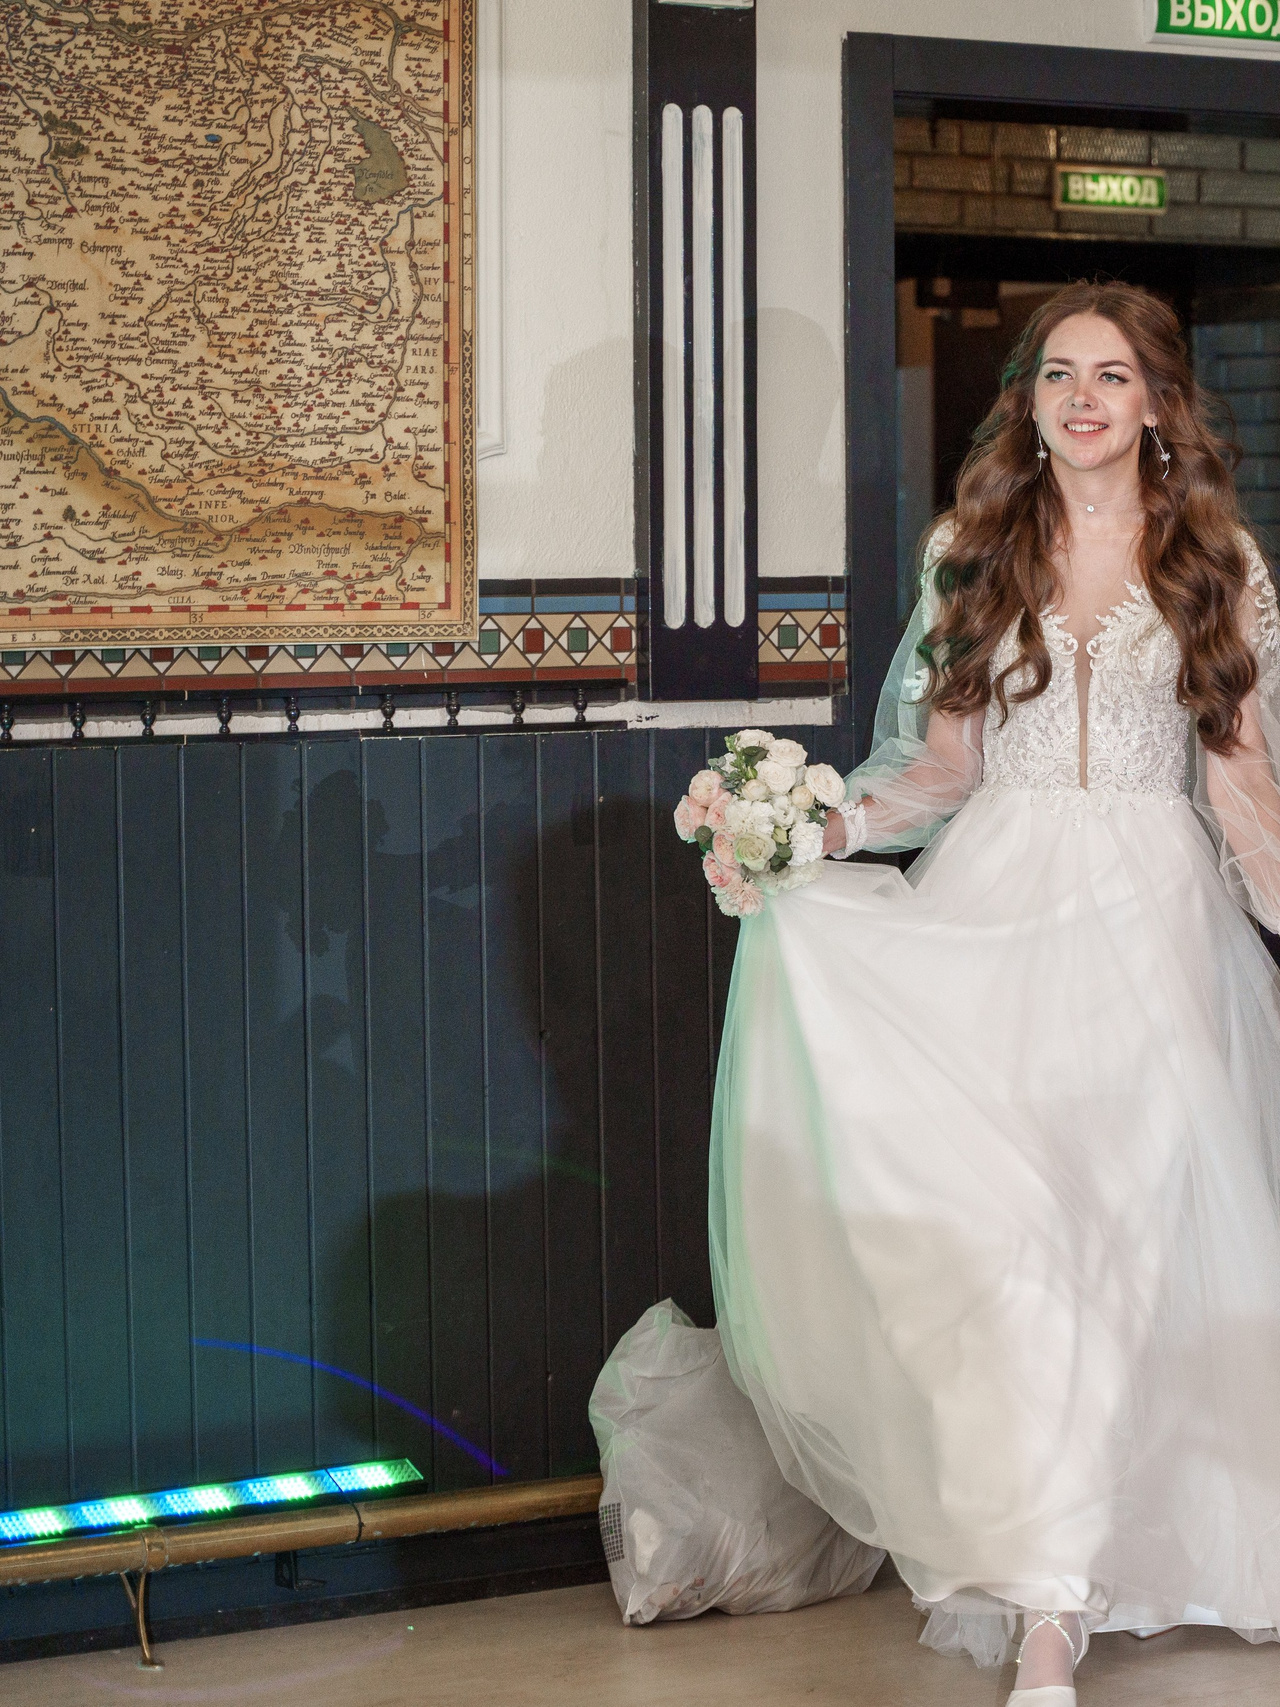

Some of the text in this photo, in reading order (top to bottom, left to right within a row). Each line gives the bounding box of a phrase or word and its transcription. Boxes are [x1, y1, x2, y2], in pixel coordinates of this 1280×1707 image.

[1067, 174, 1159, 206] ВЫХОД
[423, 293, 442, 302] NGA
[411, 348, 439, 357] RIAE
[405, 365, 437, 374] PARS.
